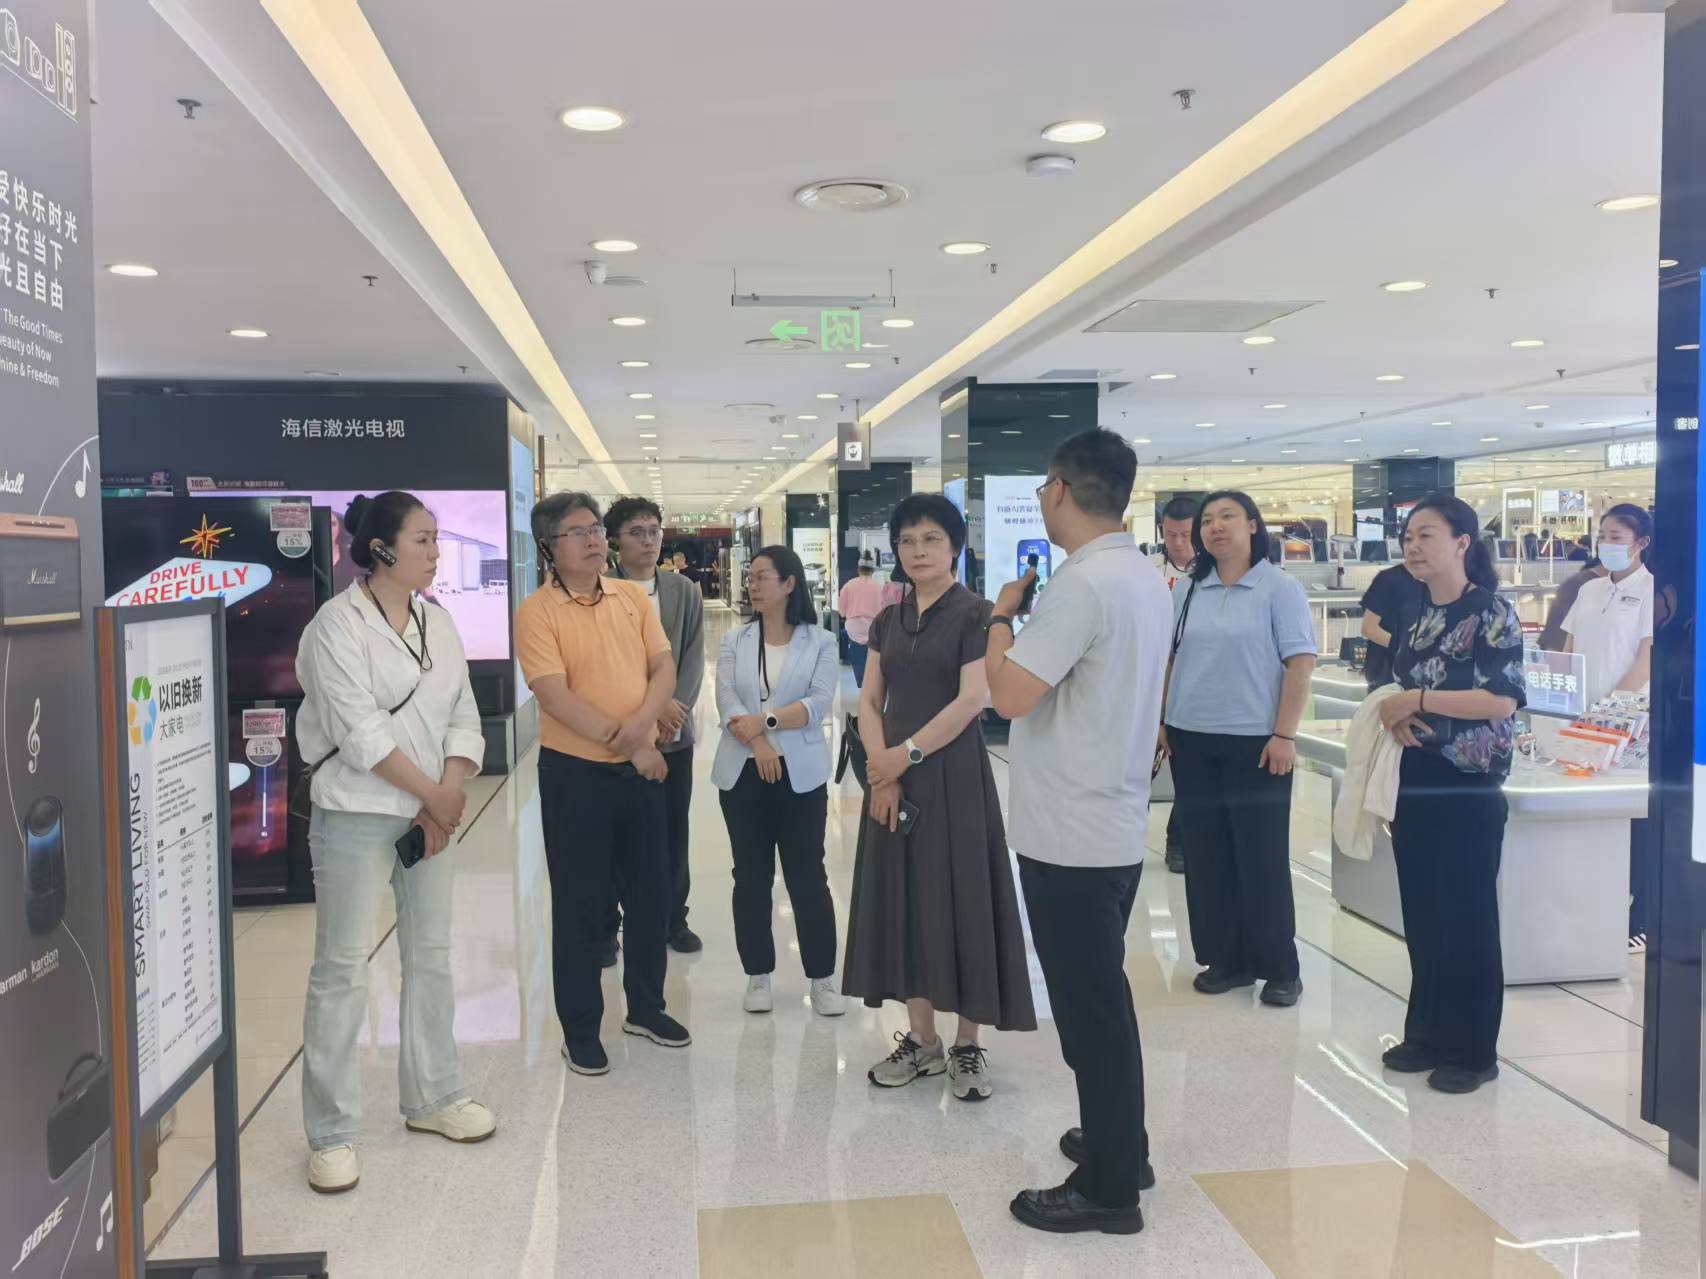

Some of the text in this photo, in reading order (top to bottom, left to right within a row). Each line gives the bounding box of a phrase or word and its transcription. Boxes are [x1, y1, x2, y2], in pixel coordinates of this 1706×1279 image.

[3, 308, 63, 344] The Good Times
[26, 341, 35, 357] of
[35, 344, 52, 363] Now
[27, 364, 60, 389] Freedom
[281, 418, 406, 438] 海信激光电视
[116, 565, 248, 607] CAREFULLY
[150, 561, 201, 585] DRIVE
[159, 675, 202, 713] 以旧换新
[1527, 670, 1577, 693] 电话手表
[159, 715, 184, 741] 大家电
[130, 772, 143, 871] LIVING
[133, 881, 146, 978] SMART
[31, 948, 59, 974] kardon
[12, 1196, 70, 1271] BOSE
